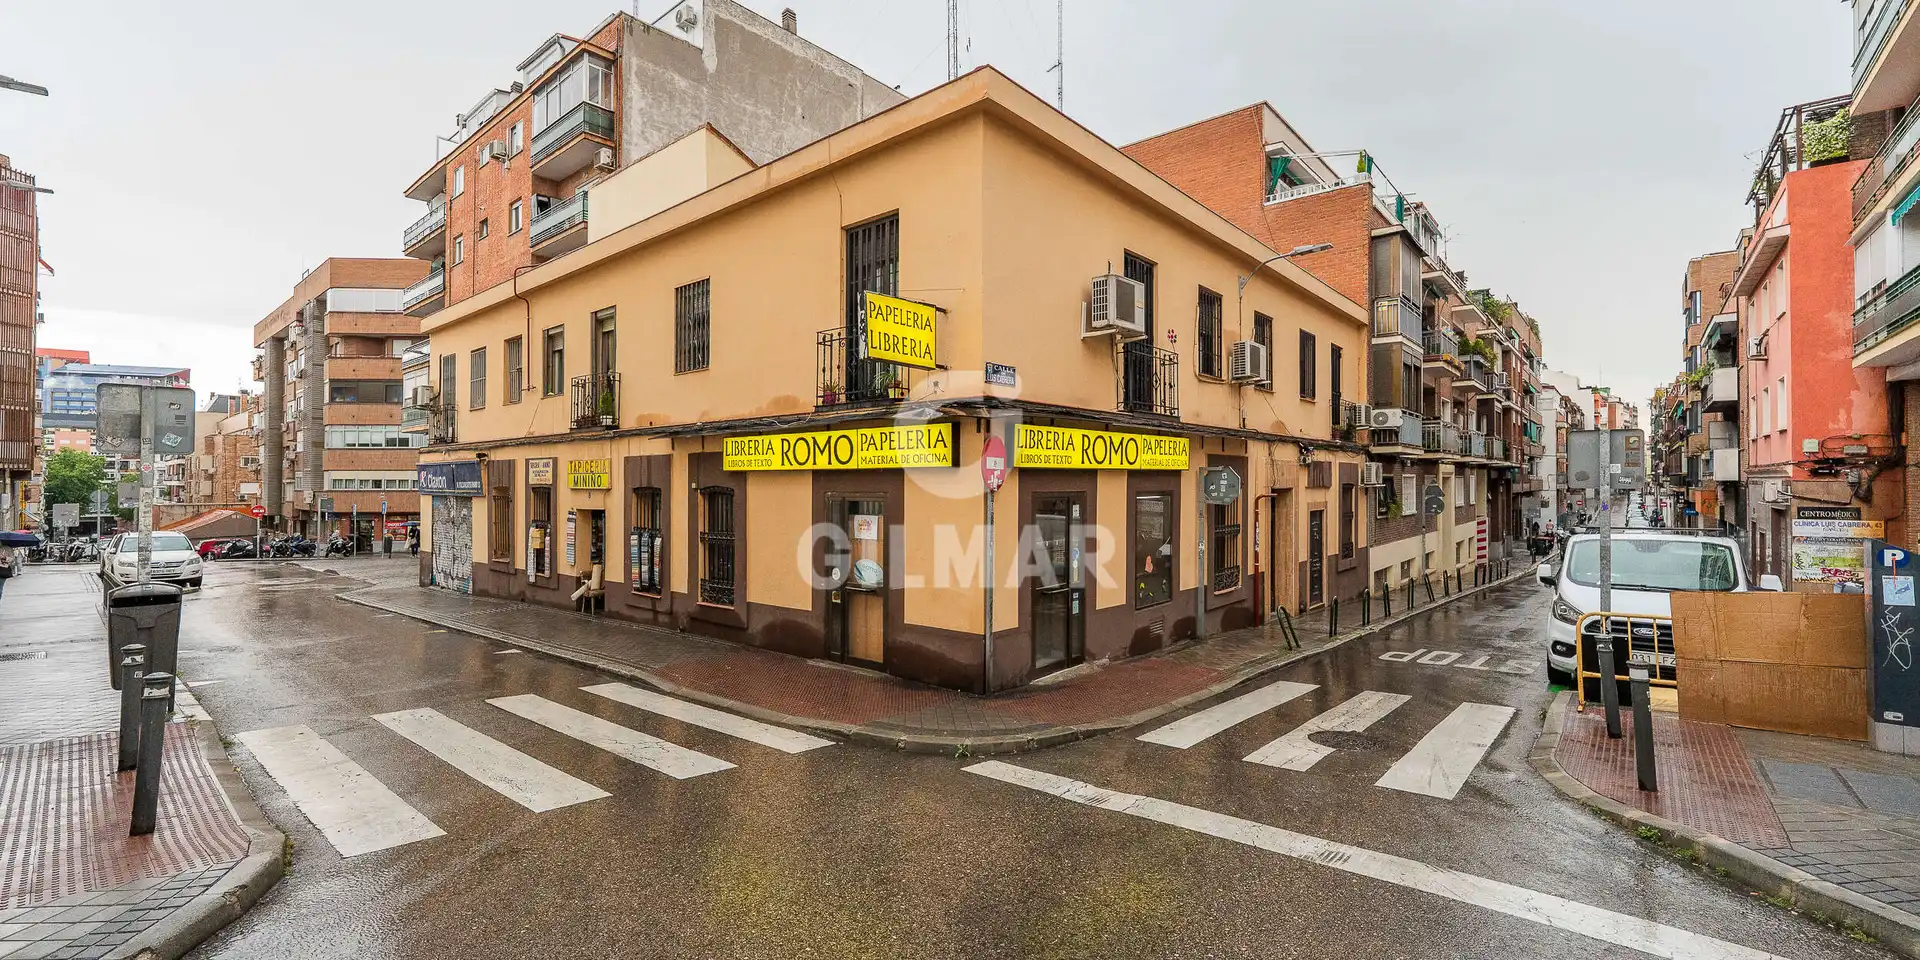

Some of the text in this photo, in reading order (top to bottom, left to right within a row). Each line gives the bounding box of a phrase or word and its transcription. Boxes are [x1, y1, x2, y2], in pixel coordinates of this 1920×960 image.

[869, 301, 933, 332] PAPELERIA
[870, 329, 933, 360] LIBRERIA
[993, 365, 1014, 374] CALLE
[725, 438, 775, 456] LIBRERIA
[860, 429, 948, 452] PAPELERIA
[1017, 428, 1075, 451] LIBRERIA
[1142, 438, 1188, 456] PAPELERIA
[781, 434, 854, 467] ROMO
[860, 452, 949, 465] MATERIAL DE OFICINA
[1081, 434, 1139, 465] ROMO
[570, 460, 607, 473] TAPICERIA
[728, 458, 772, 467] LIBROS DE TEXTO
[1020, 453, 1072, 465] LIBROS DE TEXTO
[1800, 510, 1831, 518] CENTRO
[1884, 549, 1905, 567] P
[1632, 653, 1651, 663] 031
